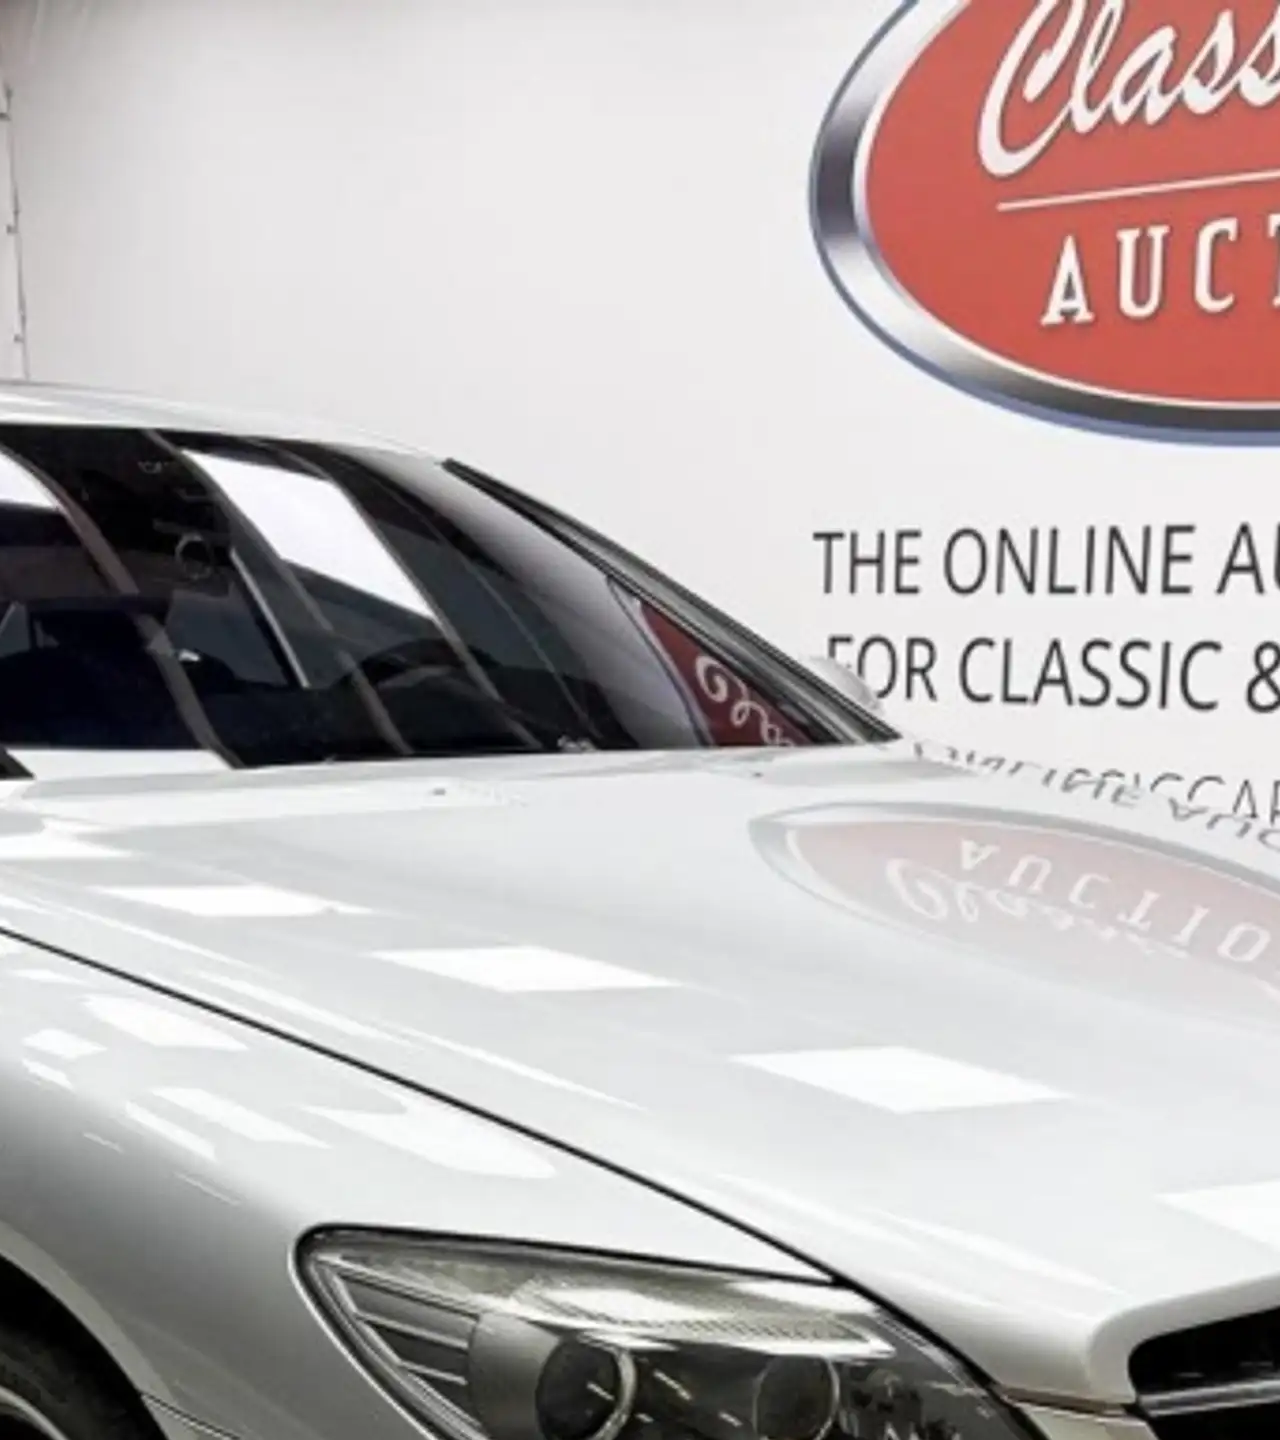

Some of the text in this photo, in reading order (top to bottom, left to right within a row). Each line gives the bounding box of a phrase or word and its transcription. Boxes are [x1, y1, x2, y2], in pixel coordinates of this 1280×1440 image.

[812, 529, 923, 595] THE
[942, 523, 1197, 597] ONLINE
[958, 635, 1223, 711] CLASSIC
